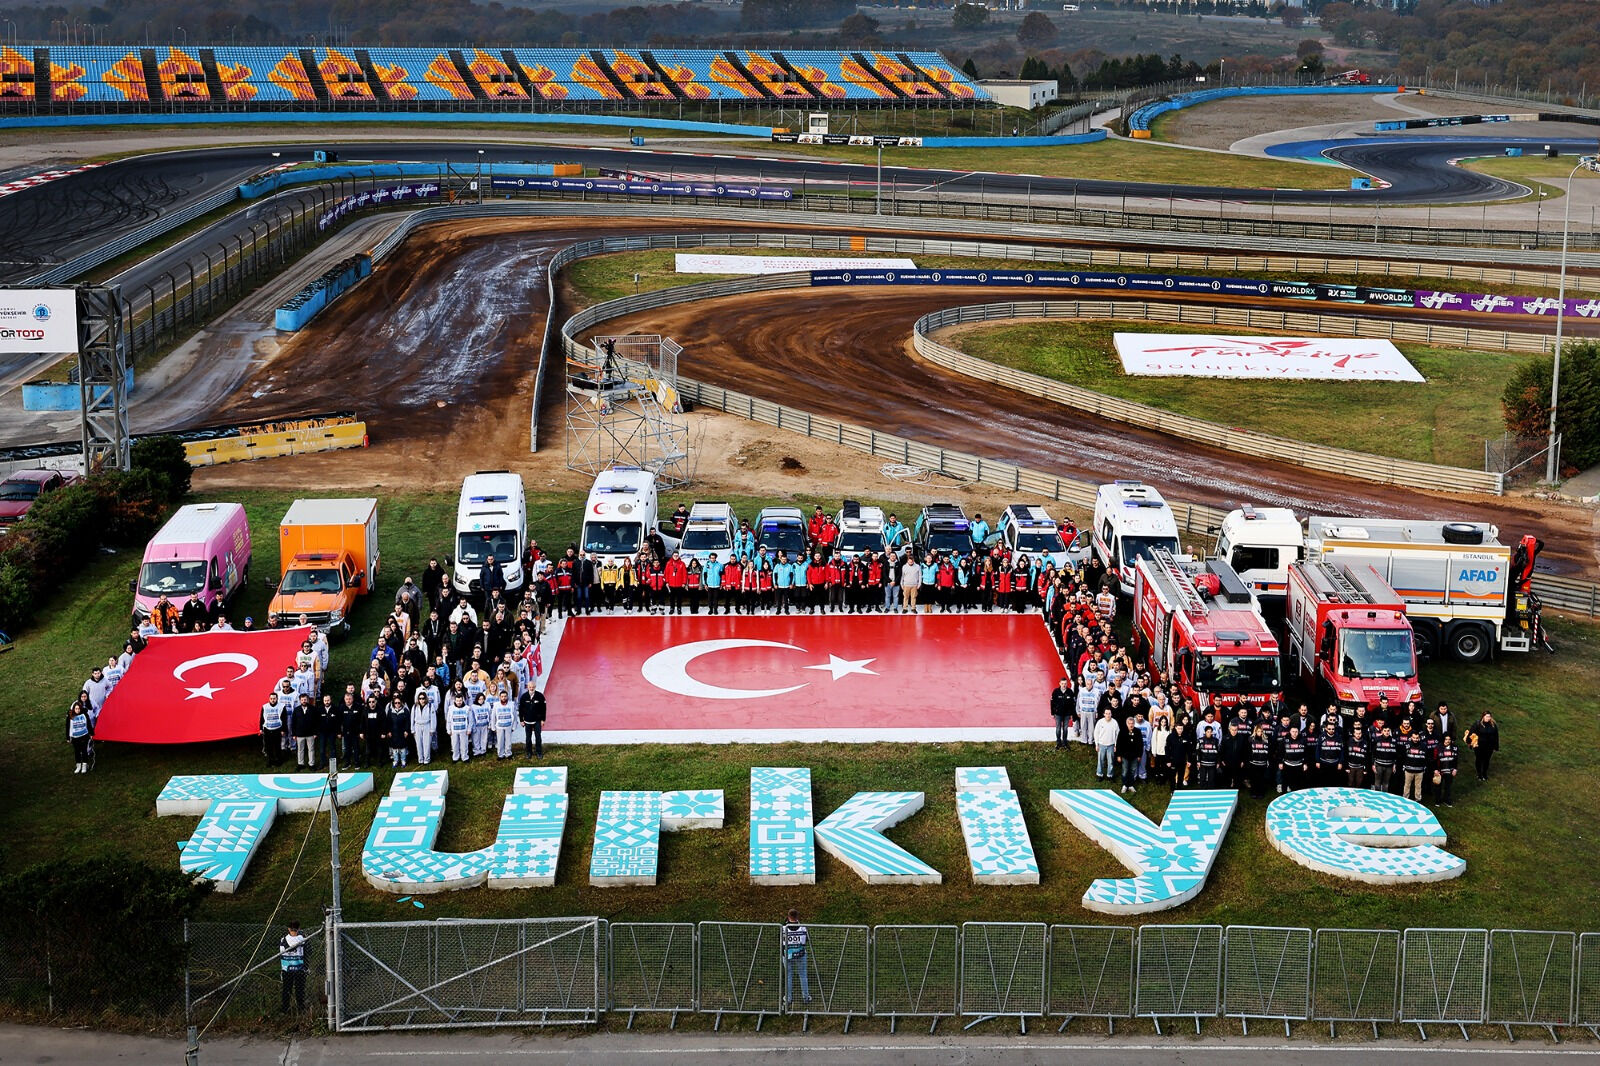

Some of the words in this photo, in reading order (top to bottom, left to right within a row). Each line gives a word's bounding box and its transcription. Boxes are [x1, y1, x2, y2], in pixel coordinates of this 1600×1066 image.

[1273, 286, 1315, 295] #WORLDRX
[1328, 289, 1339, 297] RX
[1369, 293, 1413, 302] #WORLDRX
[1146, 363, 1400, 375] goturkiye.com
[284, 528, 289, 536] 3
[1459, 569, 1497, 582] AFAD
